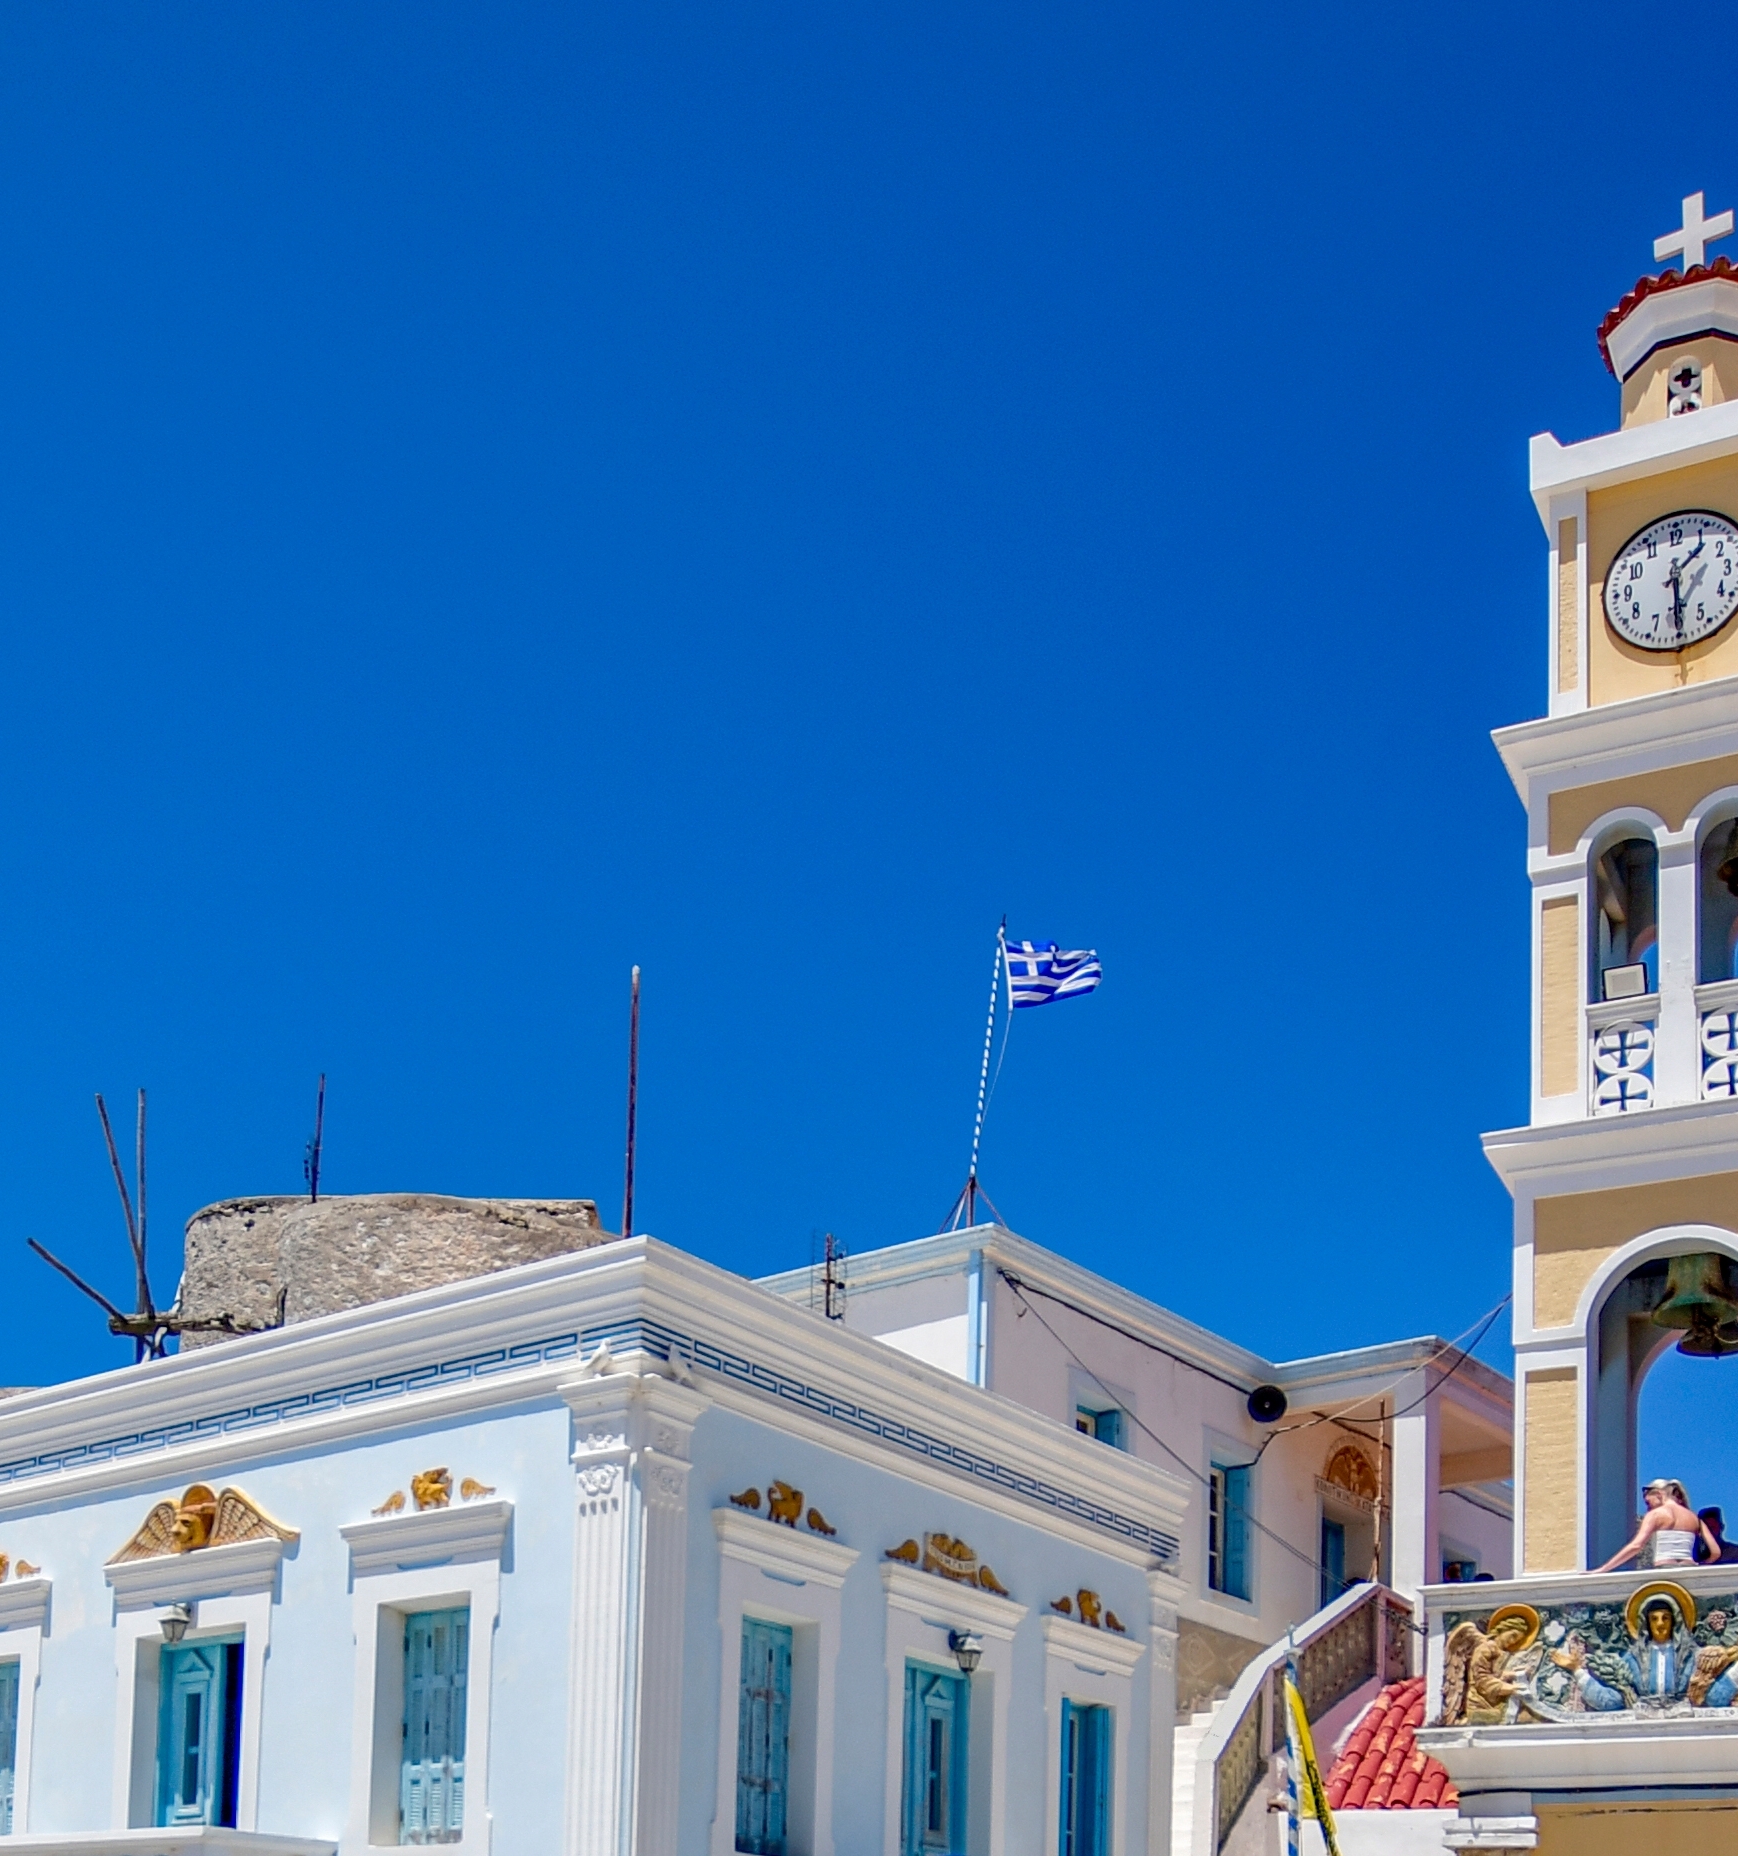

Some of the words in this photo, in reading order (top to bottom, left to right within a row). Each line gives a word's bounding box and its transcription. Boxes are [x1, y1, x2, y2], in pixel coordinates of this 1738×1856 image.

[1669, 529, 1683, 547] 12
[1647, 541, 1658, 560] 11
[1715, 541, 1724, 558] 2
[1629, 562, 1644, 581] 10
[1723, 558, 1732, 576] 3
[1624, 585, 1633, 602] 9
[1717, 579, 1726, 598] 4
[1632, 602, 1641, 620] 8
[1696, 602, 1705, 621] 5
[1652, 613, 1660, 632] 7
